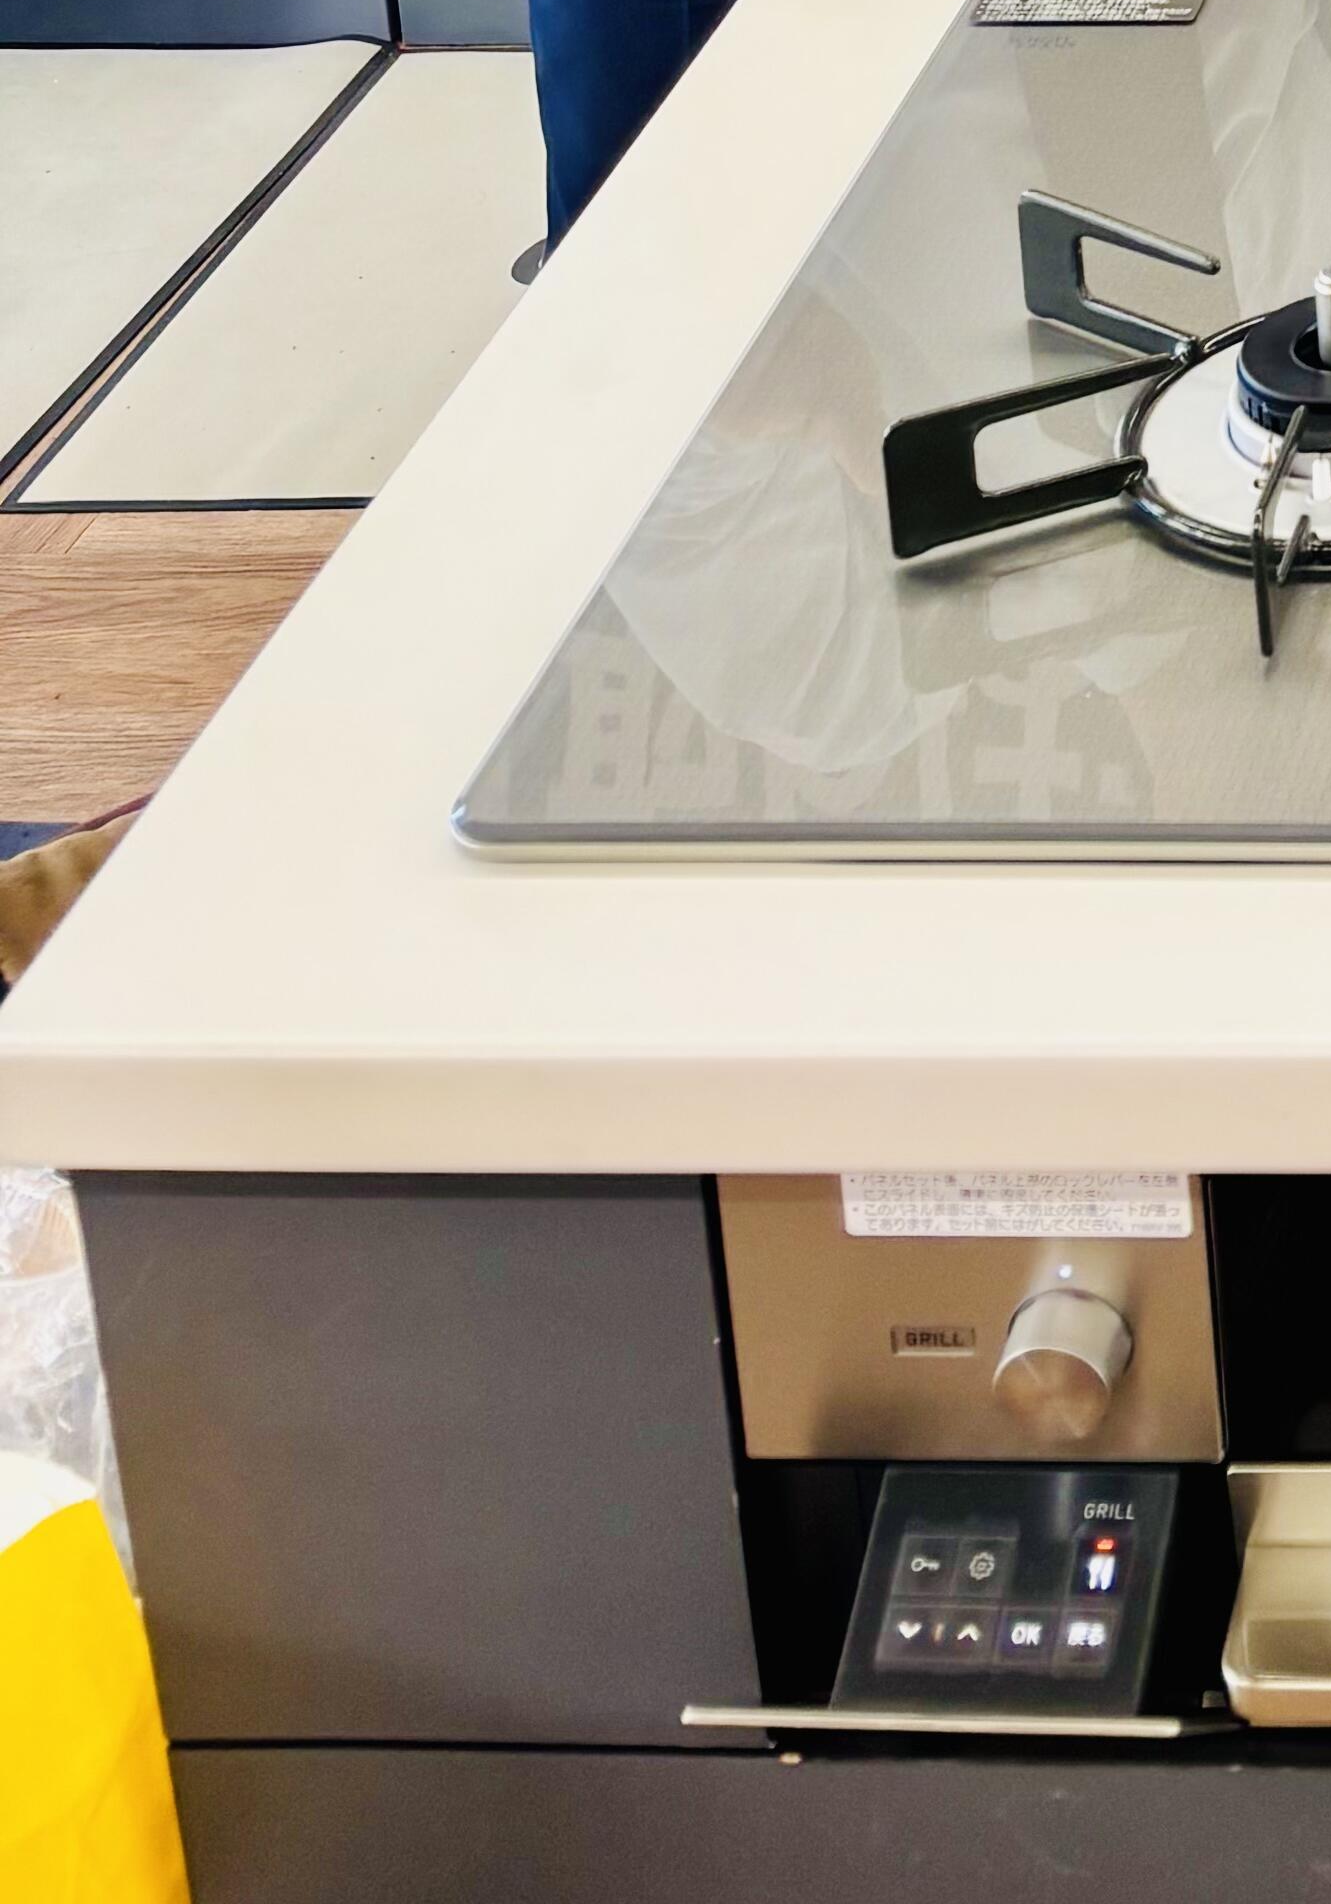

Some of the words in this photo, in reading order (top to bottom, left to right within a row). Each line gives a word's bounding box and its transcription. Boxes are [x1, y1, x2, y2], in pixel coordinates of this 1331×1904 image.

[906, 1331, 964, 1347] GRILL
[1083, 1502, 1137, 1521] GRILL
[1010, 1622, 1042, 1646] OK
